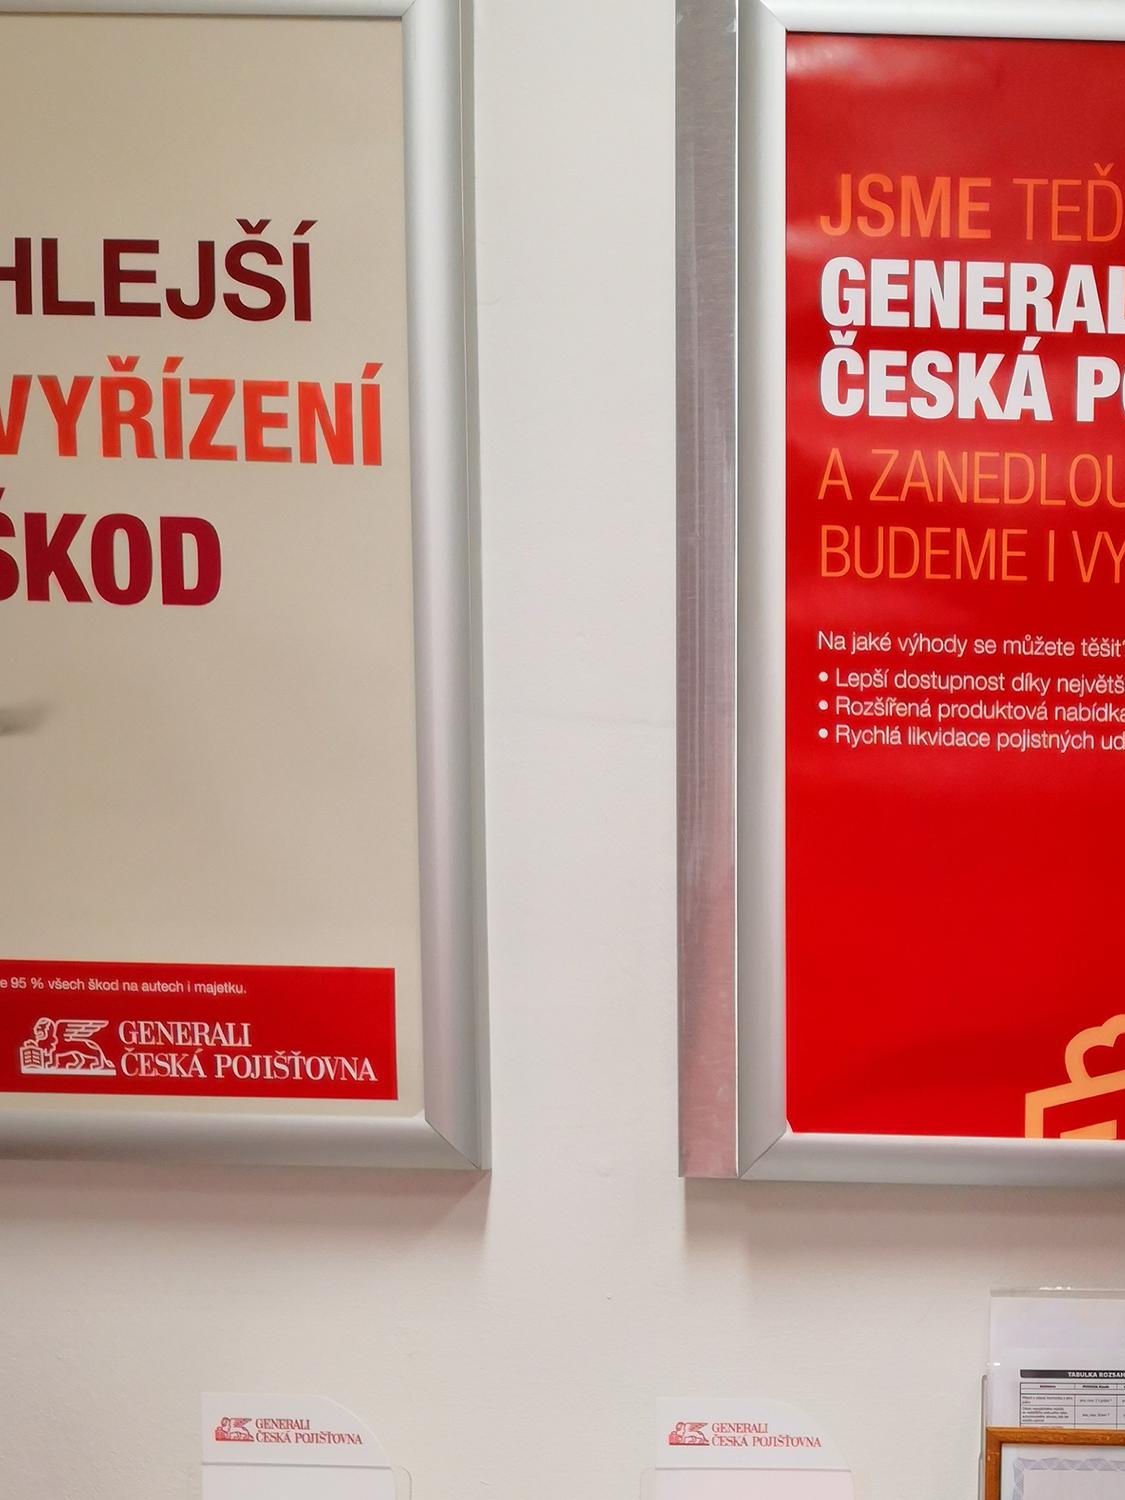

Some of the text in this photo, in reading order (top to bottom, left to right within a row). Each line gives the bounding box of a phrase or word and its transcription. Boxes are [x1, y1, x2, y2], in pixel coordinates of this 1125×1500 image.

[820, 163, 1123, 242] JSME TEĎ
[820, 331, 1051, 421] ČESKÁ
[0, 355, 383, 466] VYŘÍZENÍ
[818, 448, 851, 500] A
[820, 526, 1028, 581] BUDEME
[1048, 530, 1055, 580] I
[818, 632, 846, 651] Na
[850, 631, 892, 654] jaké
[898, 633, 966, 657] výhody
[974, 639, 996, 654] se
[1003, 634, 1075, 656] můžete
[836, 667, 887, 691] Lepší
[894, 670, 1004, 696] dostupnost
[1012, 672, 1050, 697] díky
[836, 696, 931, 719] Rozšířená
[938, 700, 1048, 725] produktová
[836, 725, 901, 750] Rychlá
[908, 726, 990, 747] likvidace
[997, 728, 1094, 754] pojistných
[11, 977, 26, 988] 95
[31, 977, 44, 989] %
[48, 978, 85, 990] všech
[88, 979, 119, 991] škod
[123, 982, 137, 992] na
[142, 980, 184, 993] autech
[187, 981, 190, 993] i
[194, 981, 246, 996] majetku.
[119, 1021, 251, 1047] GENERALI
[121, 1047, 377, 1082] ČESKÁ POJIŠŤOVNA
[255, 1418, 310, 1431] GENERALI
[256, 1429, 363, 1445] ČESKÁ POJIŠŤOVNA
[712, 1422, 768, 1434] GENERALI
[712, 1434, 821, 1448] ČESKÁ POJIŠŤOVNA
